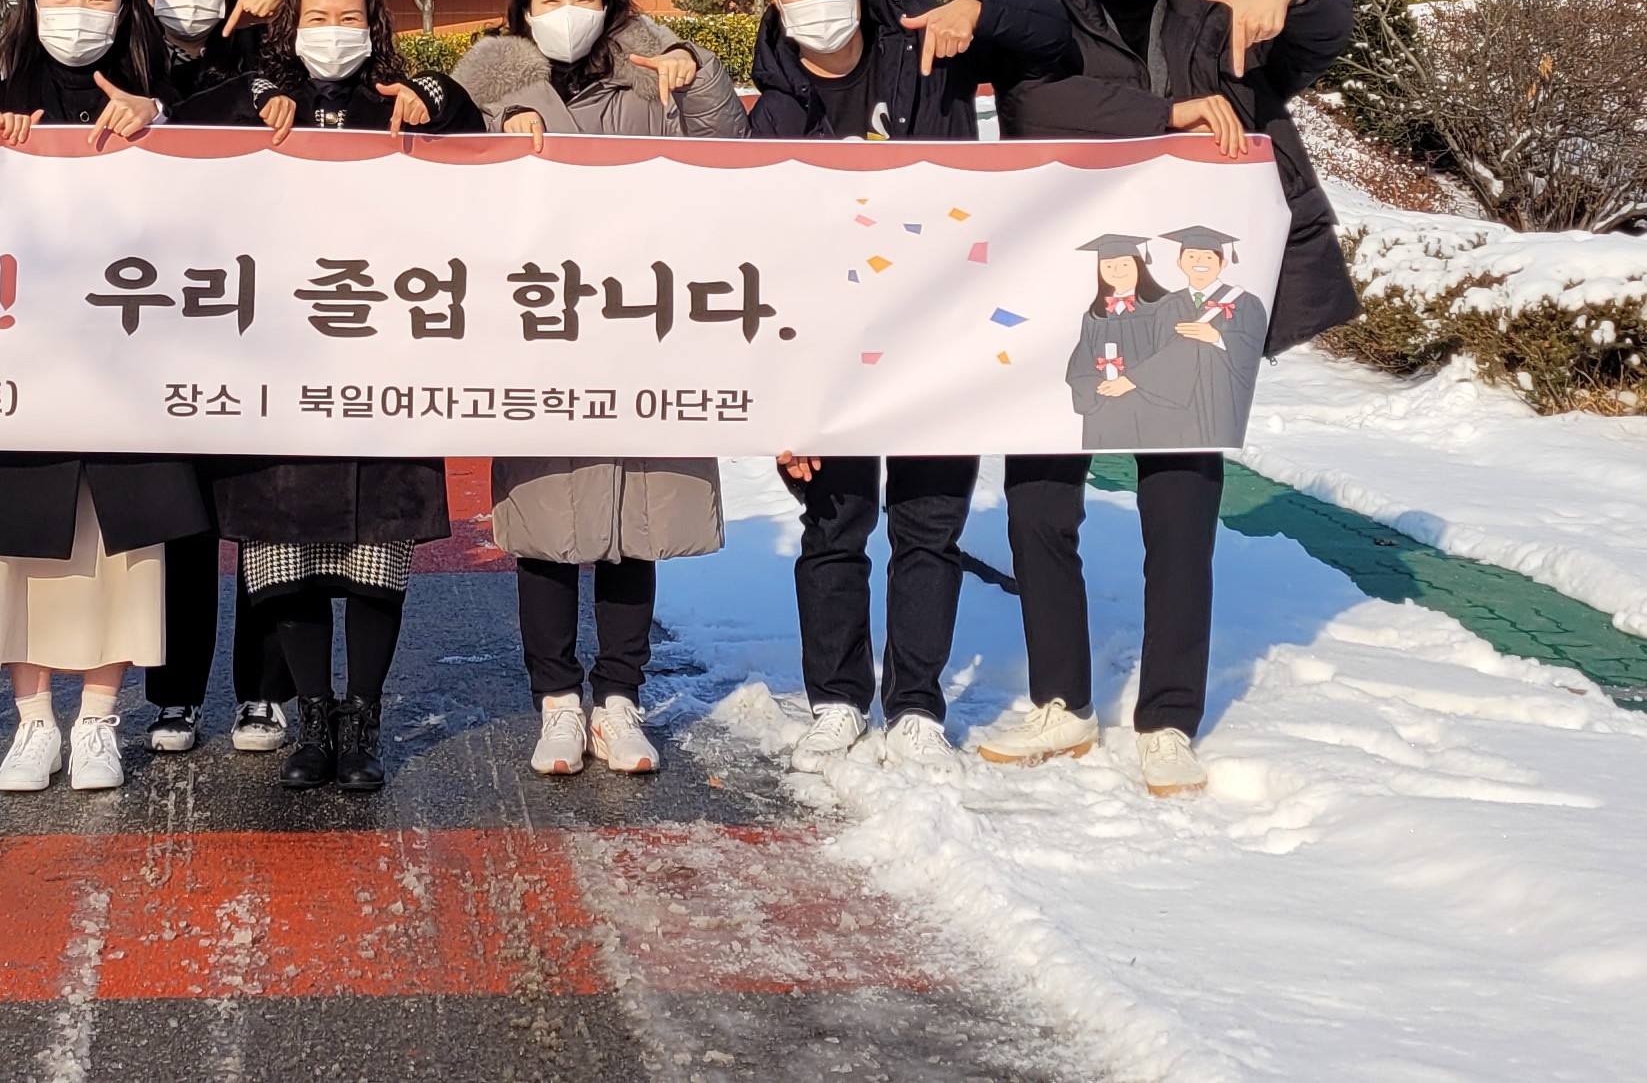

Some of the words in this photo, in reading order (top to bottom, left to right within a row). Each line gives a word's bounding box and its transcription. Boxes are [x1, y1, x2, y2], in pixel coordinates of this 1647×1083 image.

[84, 254, 256, 336] 우리
[293, 257, 468, 340] 졸업
[506, 259, 797, 345] 합니다.
[164, 383, 242, 417] 장소
[298, 385, 618, 421] 북일여자고등학교
[635, 389, 754, 422] 아단관
